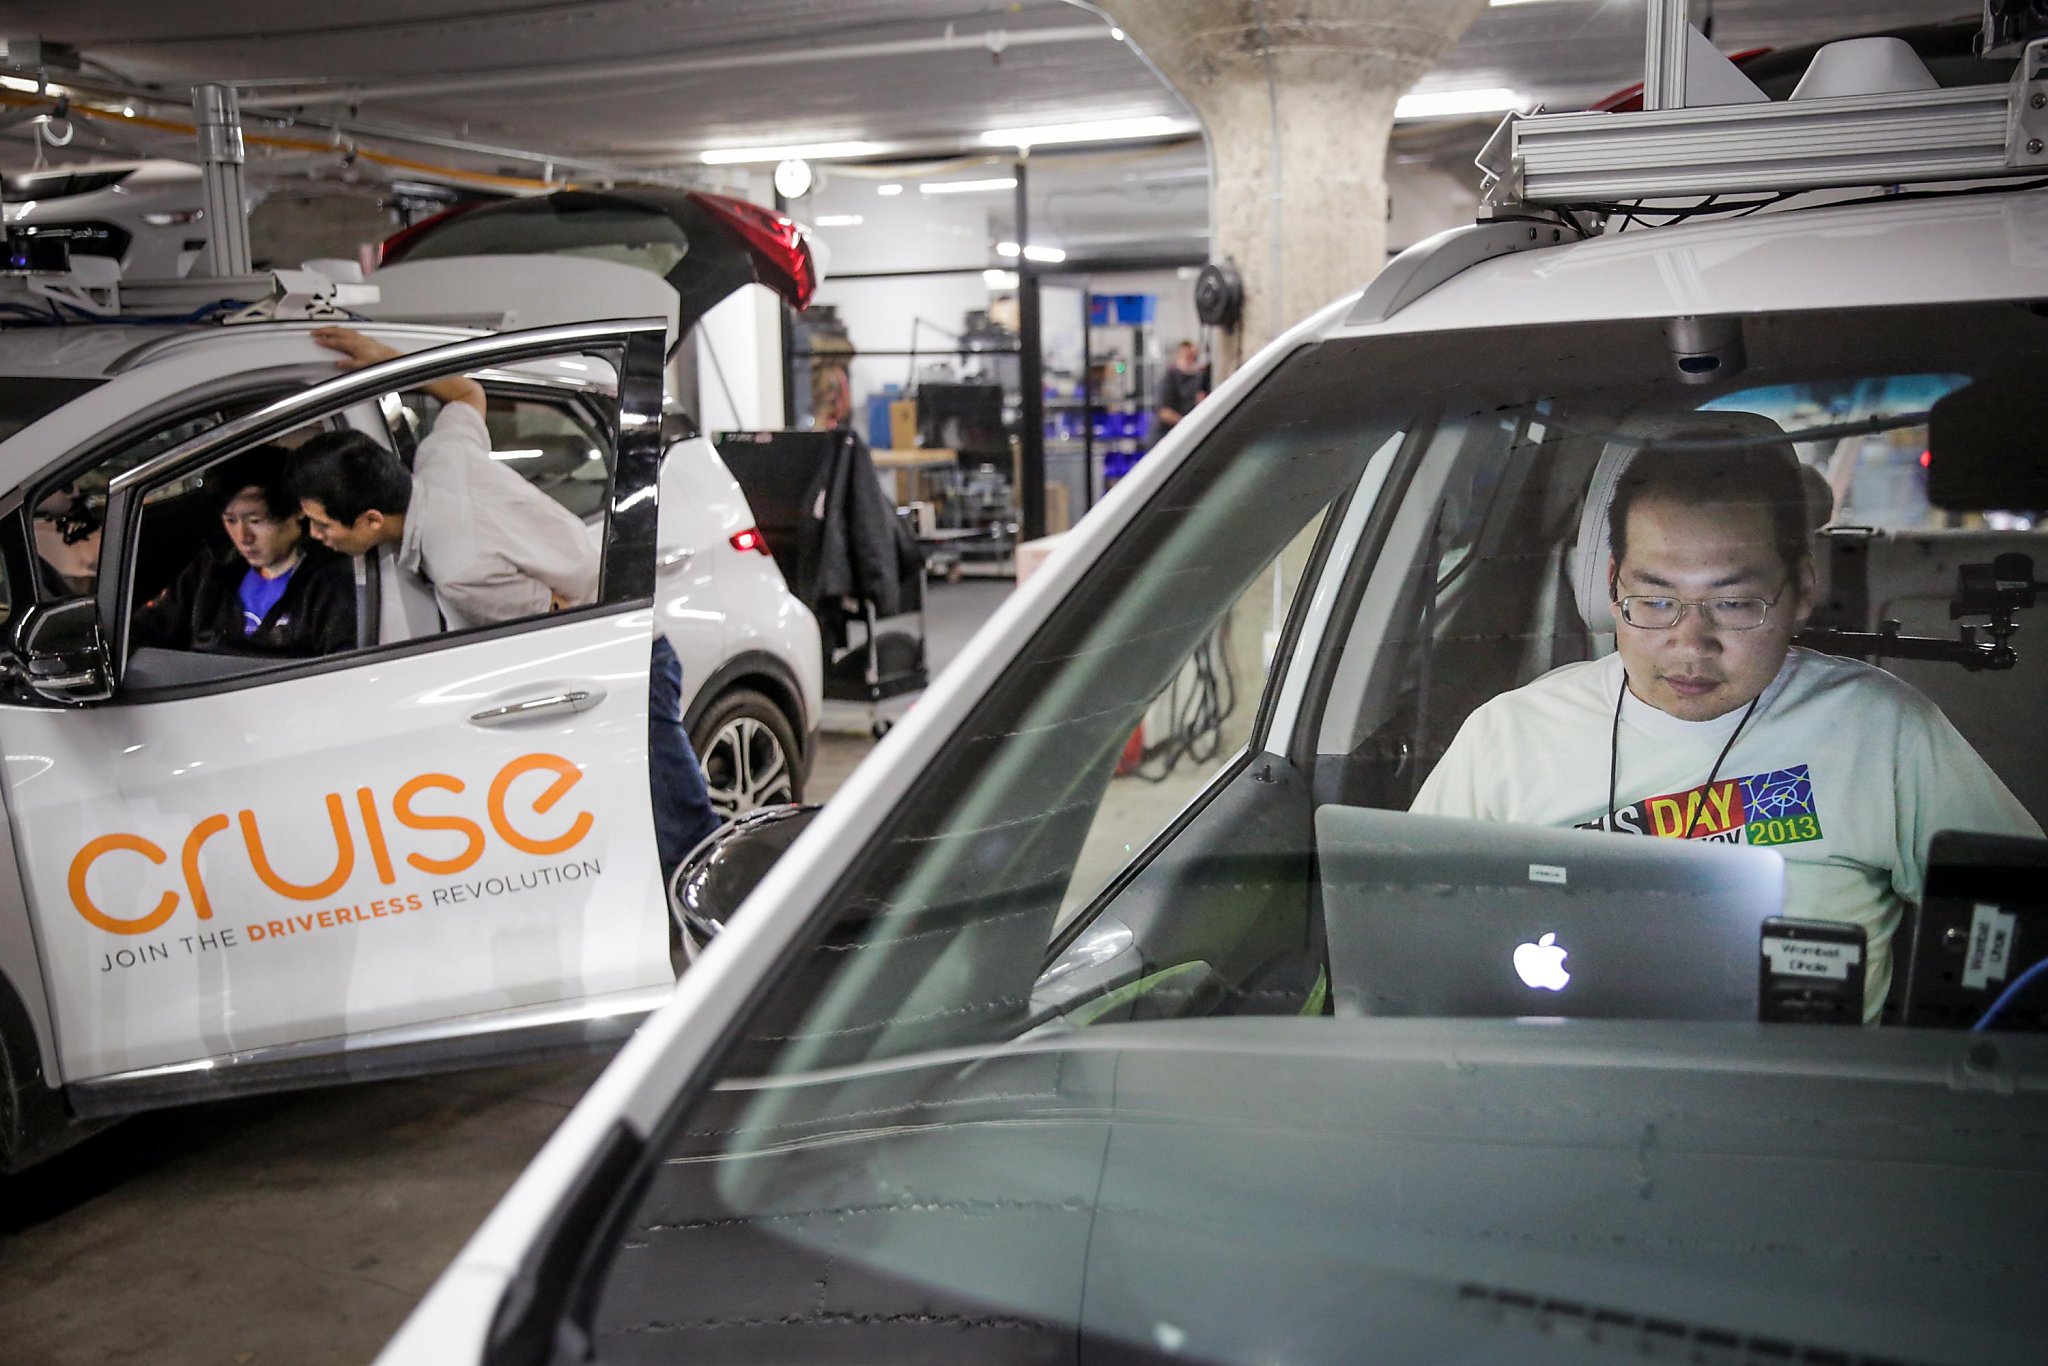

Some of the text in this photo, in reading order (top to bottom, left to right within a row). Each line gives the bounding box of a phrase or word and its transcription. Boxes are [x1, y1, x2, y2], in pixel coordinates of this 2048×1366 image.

[1652, 784, 1734, 838] DAY
[1750, 816, 1818, 845] 2013
[101, 858, 602, 972] JOIN THE DRIVERLESS REVOLUTION
